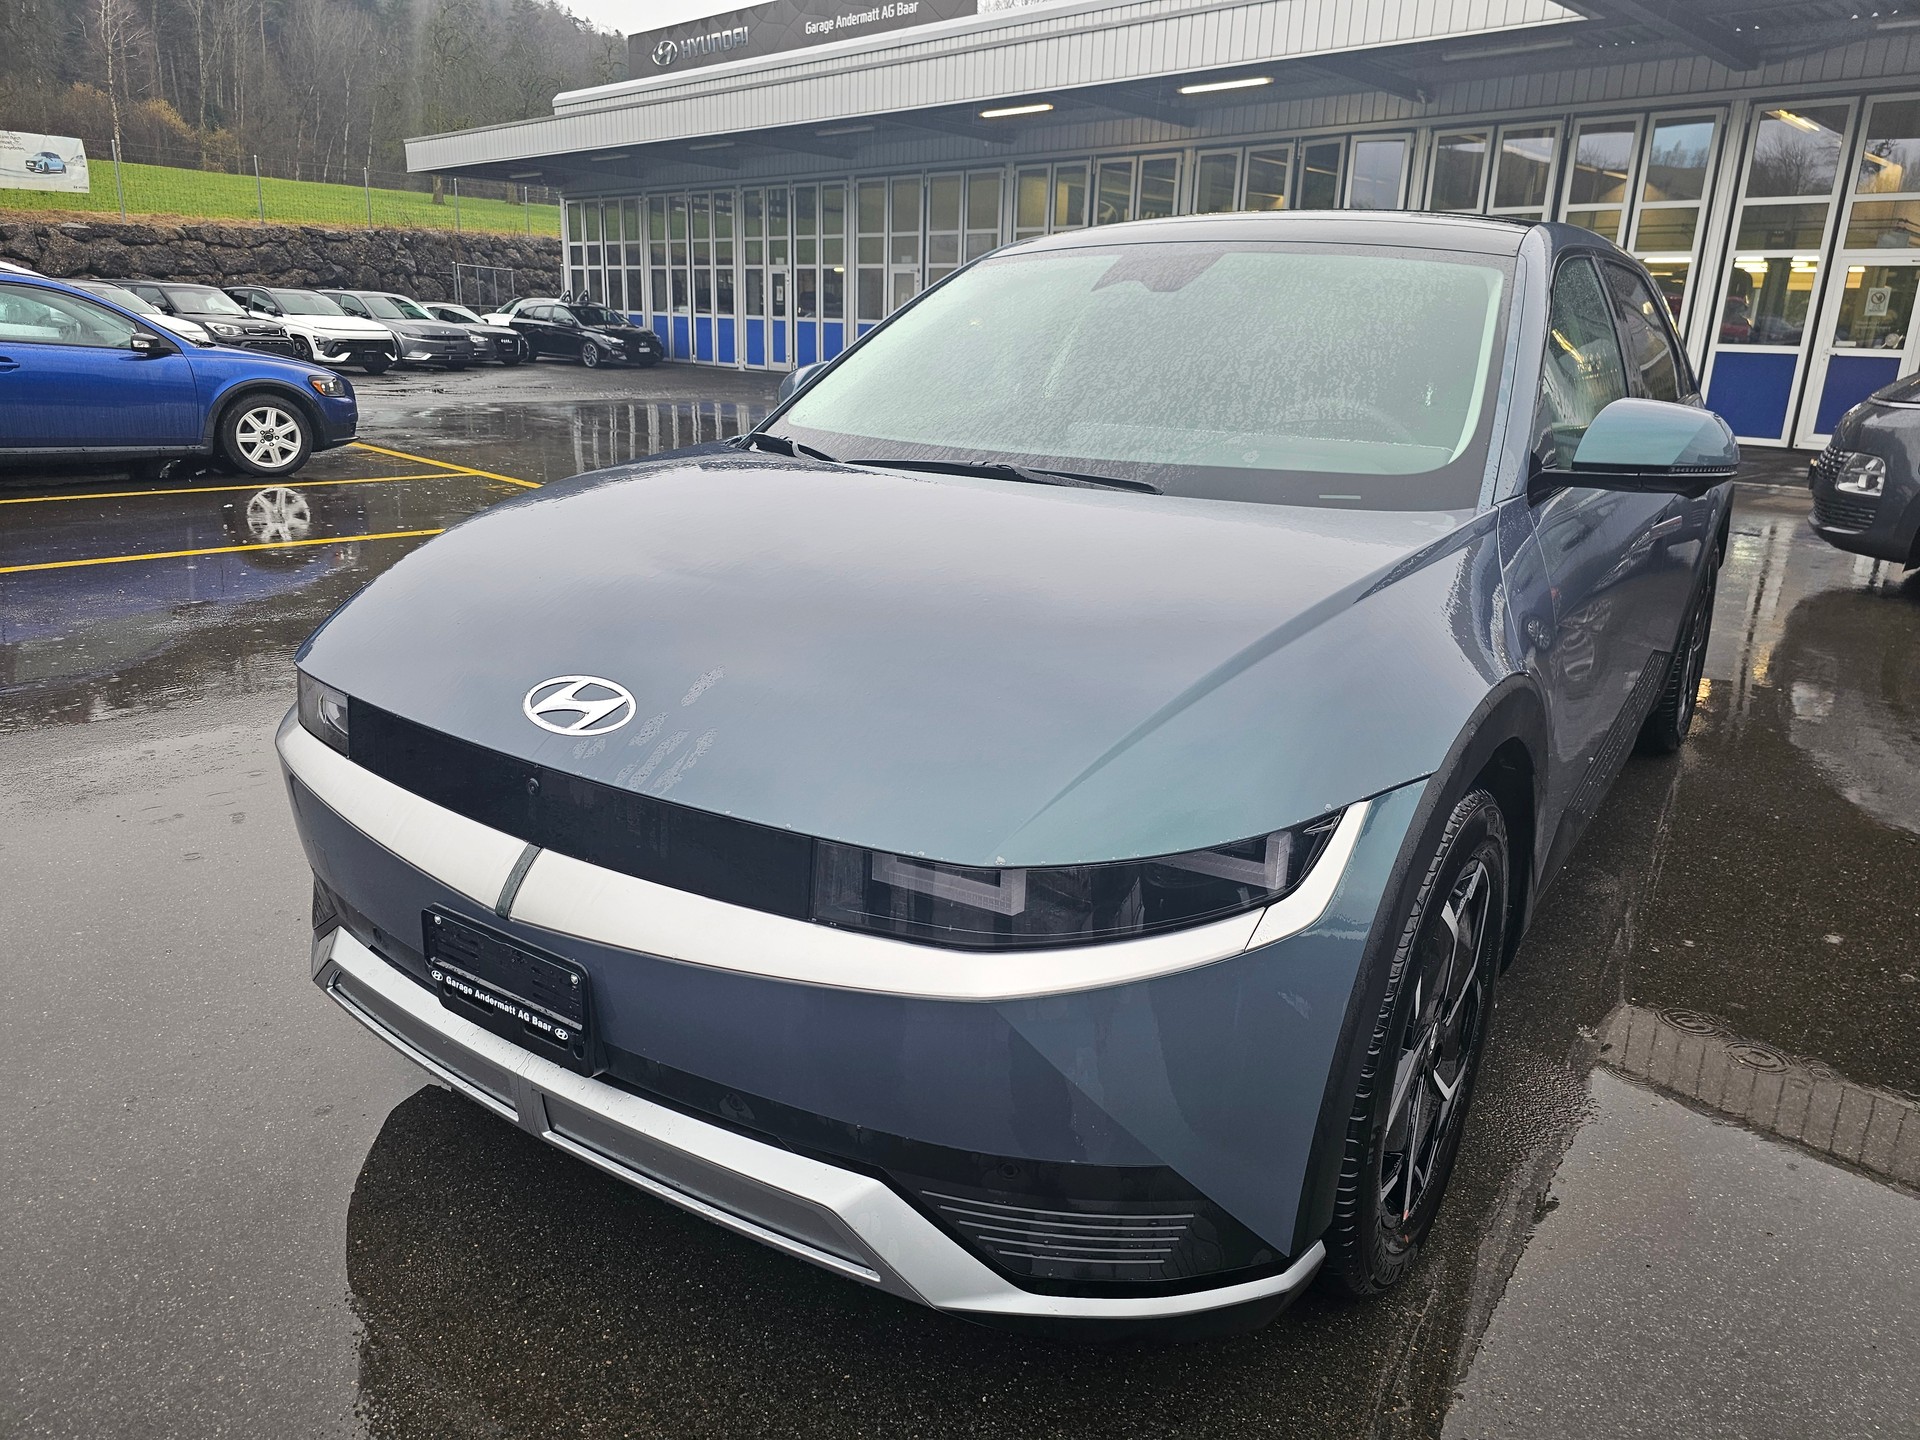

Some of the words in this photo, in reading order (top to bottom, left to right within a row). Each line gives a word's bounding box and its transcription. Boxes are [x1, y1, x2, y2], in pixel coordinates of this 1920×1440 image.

[805, 20, 834, 34] Garage
[836, 7, 880, 29] Andermatt
[881, 4, 895, 20] AG
[896, 2, 919, 16] Baar
[681, 26, 749, 59] HYUNDAI
[446, 976, 473, 995] Garage
[474, 989, 516, 1015] Andermatt
[518, 1009, 530, 1022] AG
[531, 1015, 552, 1032] Baar
